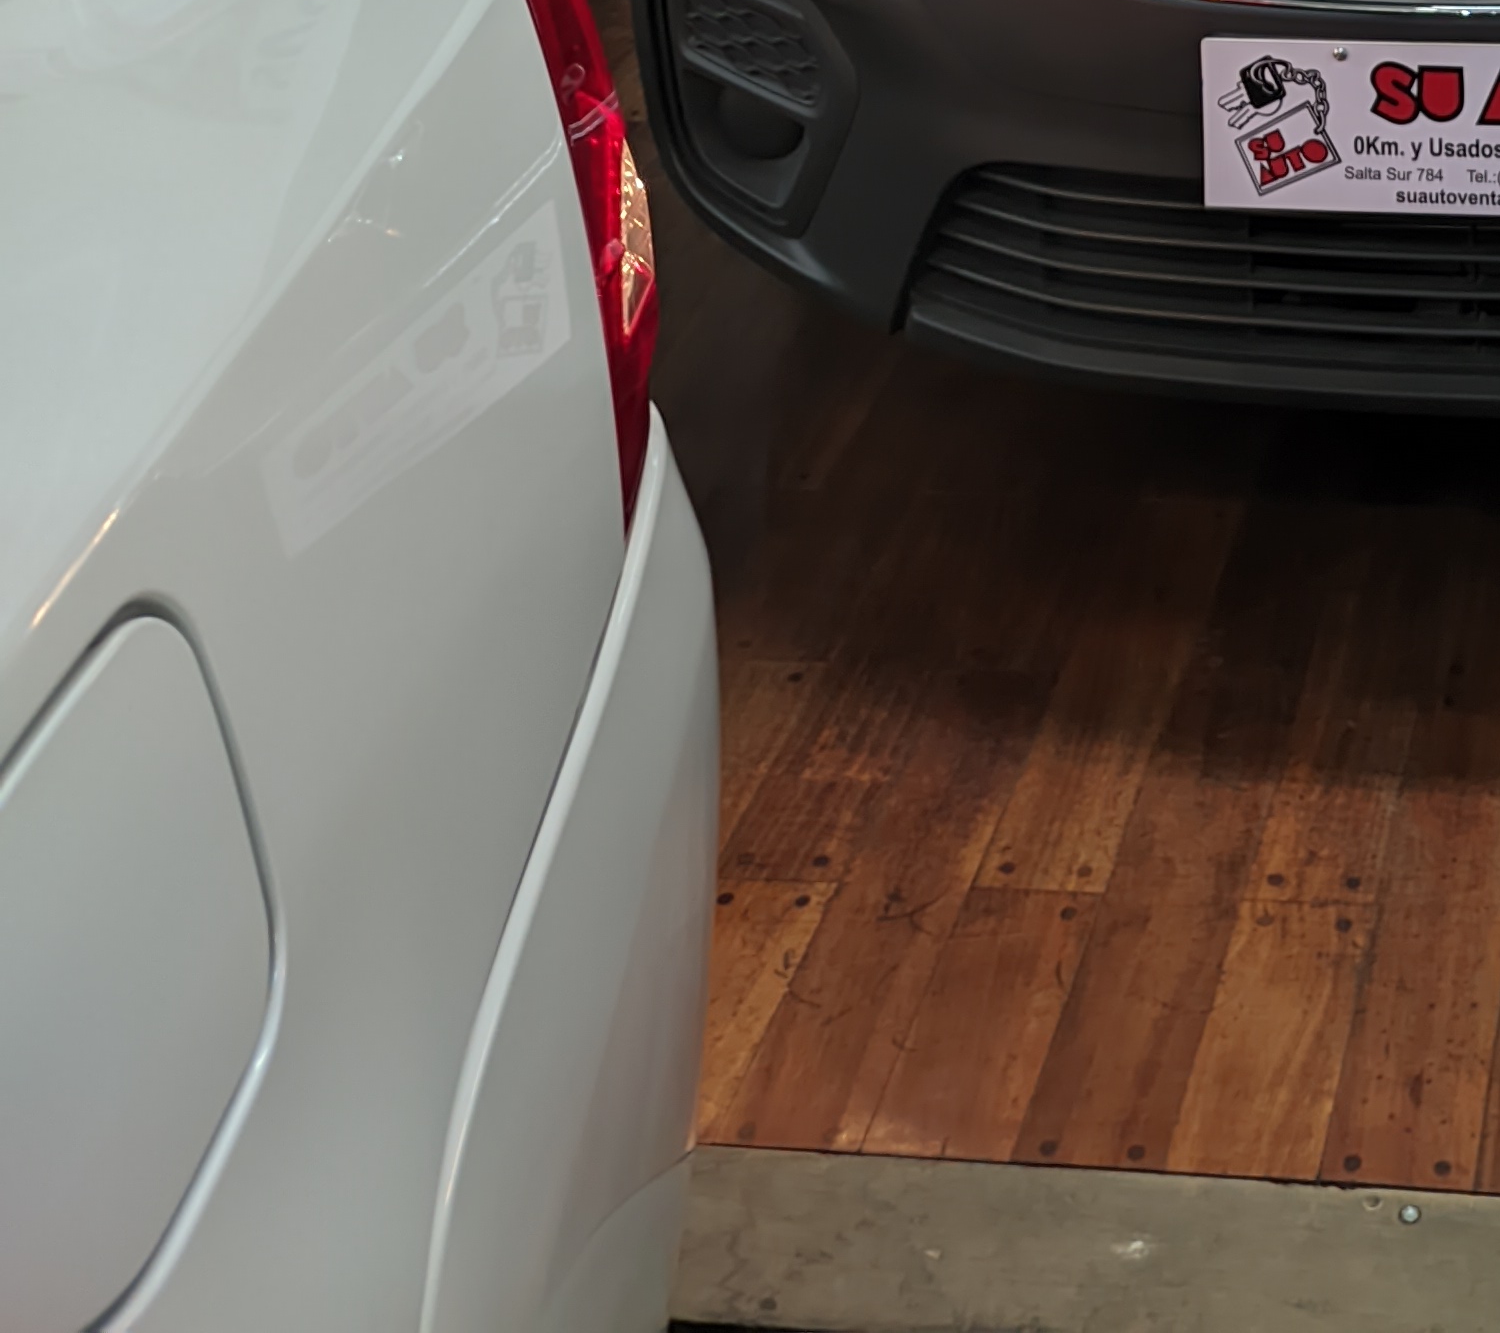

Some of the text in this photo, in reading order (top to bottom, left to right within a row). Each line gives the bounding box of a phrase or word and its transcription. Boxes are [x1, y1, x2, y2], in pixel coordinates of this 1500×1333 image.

[1370, 61, 1464, 125] SU
[1248, 128, 1285, 161] SU
[1411, 140, 1423, 161] y
[1260, 138, 1329, 186] AUTO
[1344, 166, 1382, 181] Salta
[1386, 167, 1412, 182] Sur
[1416, 168, 1444, 182] 784
